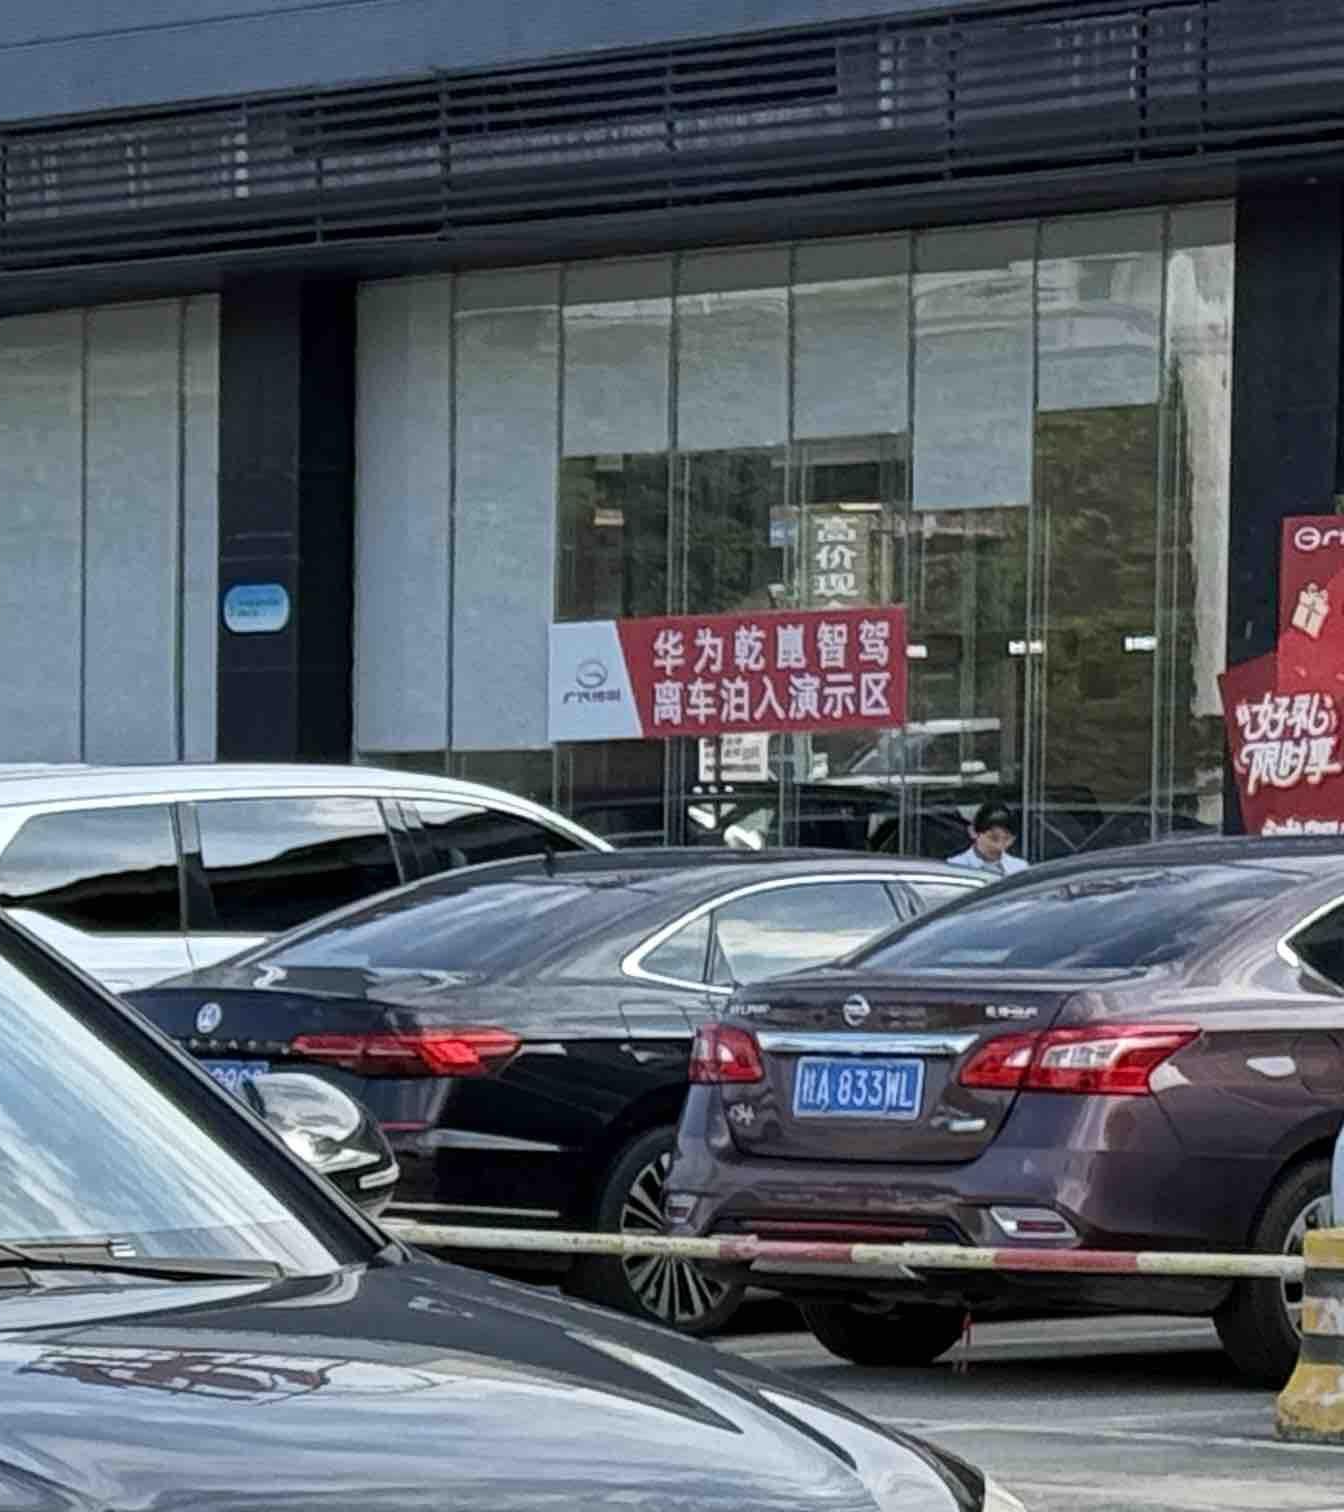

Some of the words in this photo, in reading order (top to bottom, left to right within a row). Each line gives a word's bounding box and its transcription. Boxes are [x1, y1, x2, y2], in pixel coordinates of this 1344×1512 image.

[653, 620, 890, 676] 华为乾崑智驾
[652, 671, 892, 726] 离车泊入演示区
